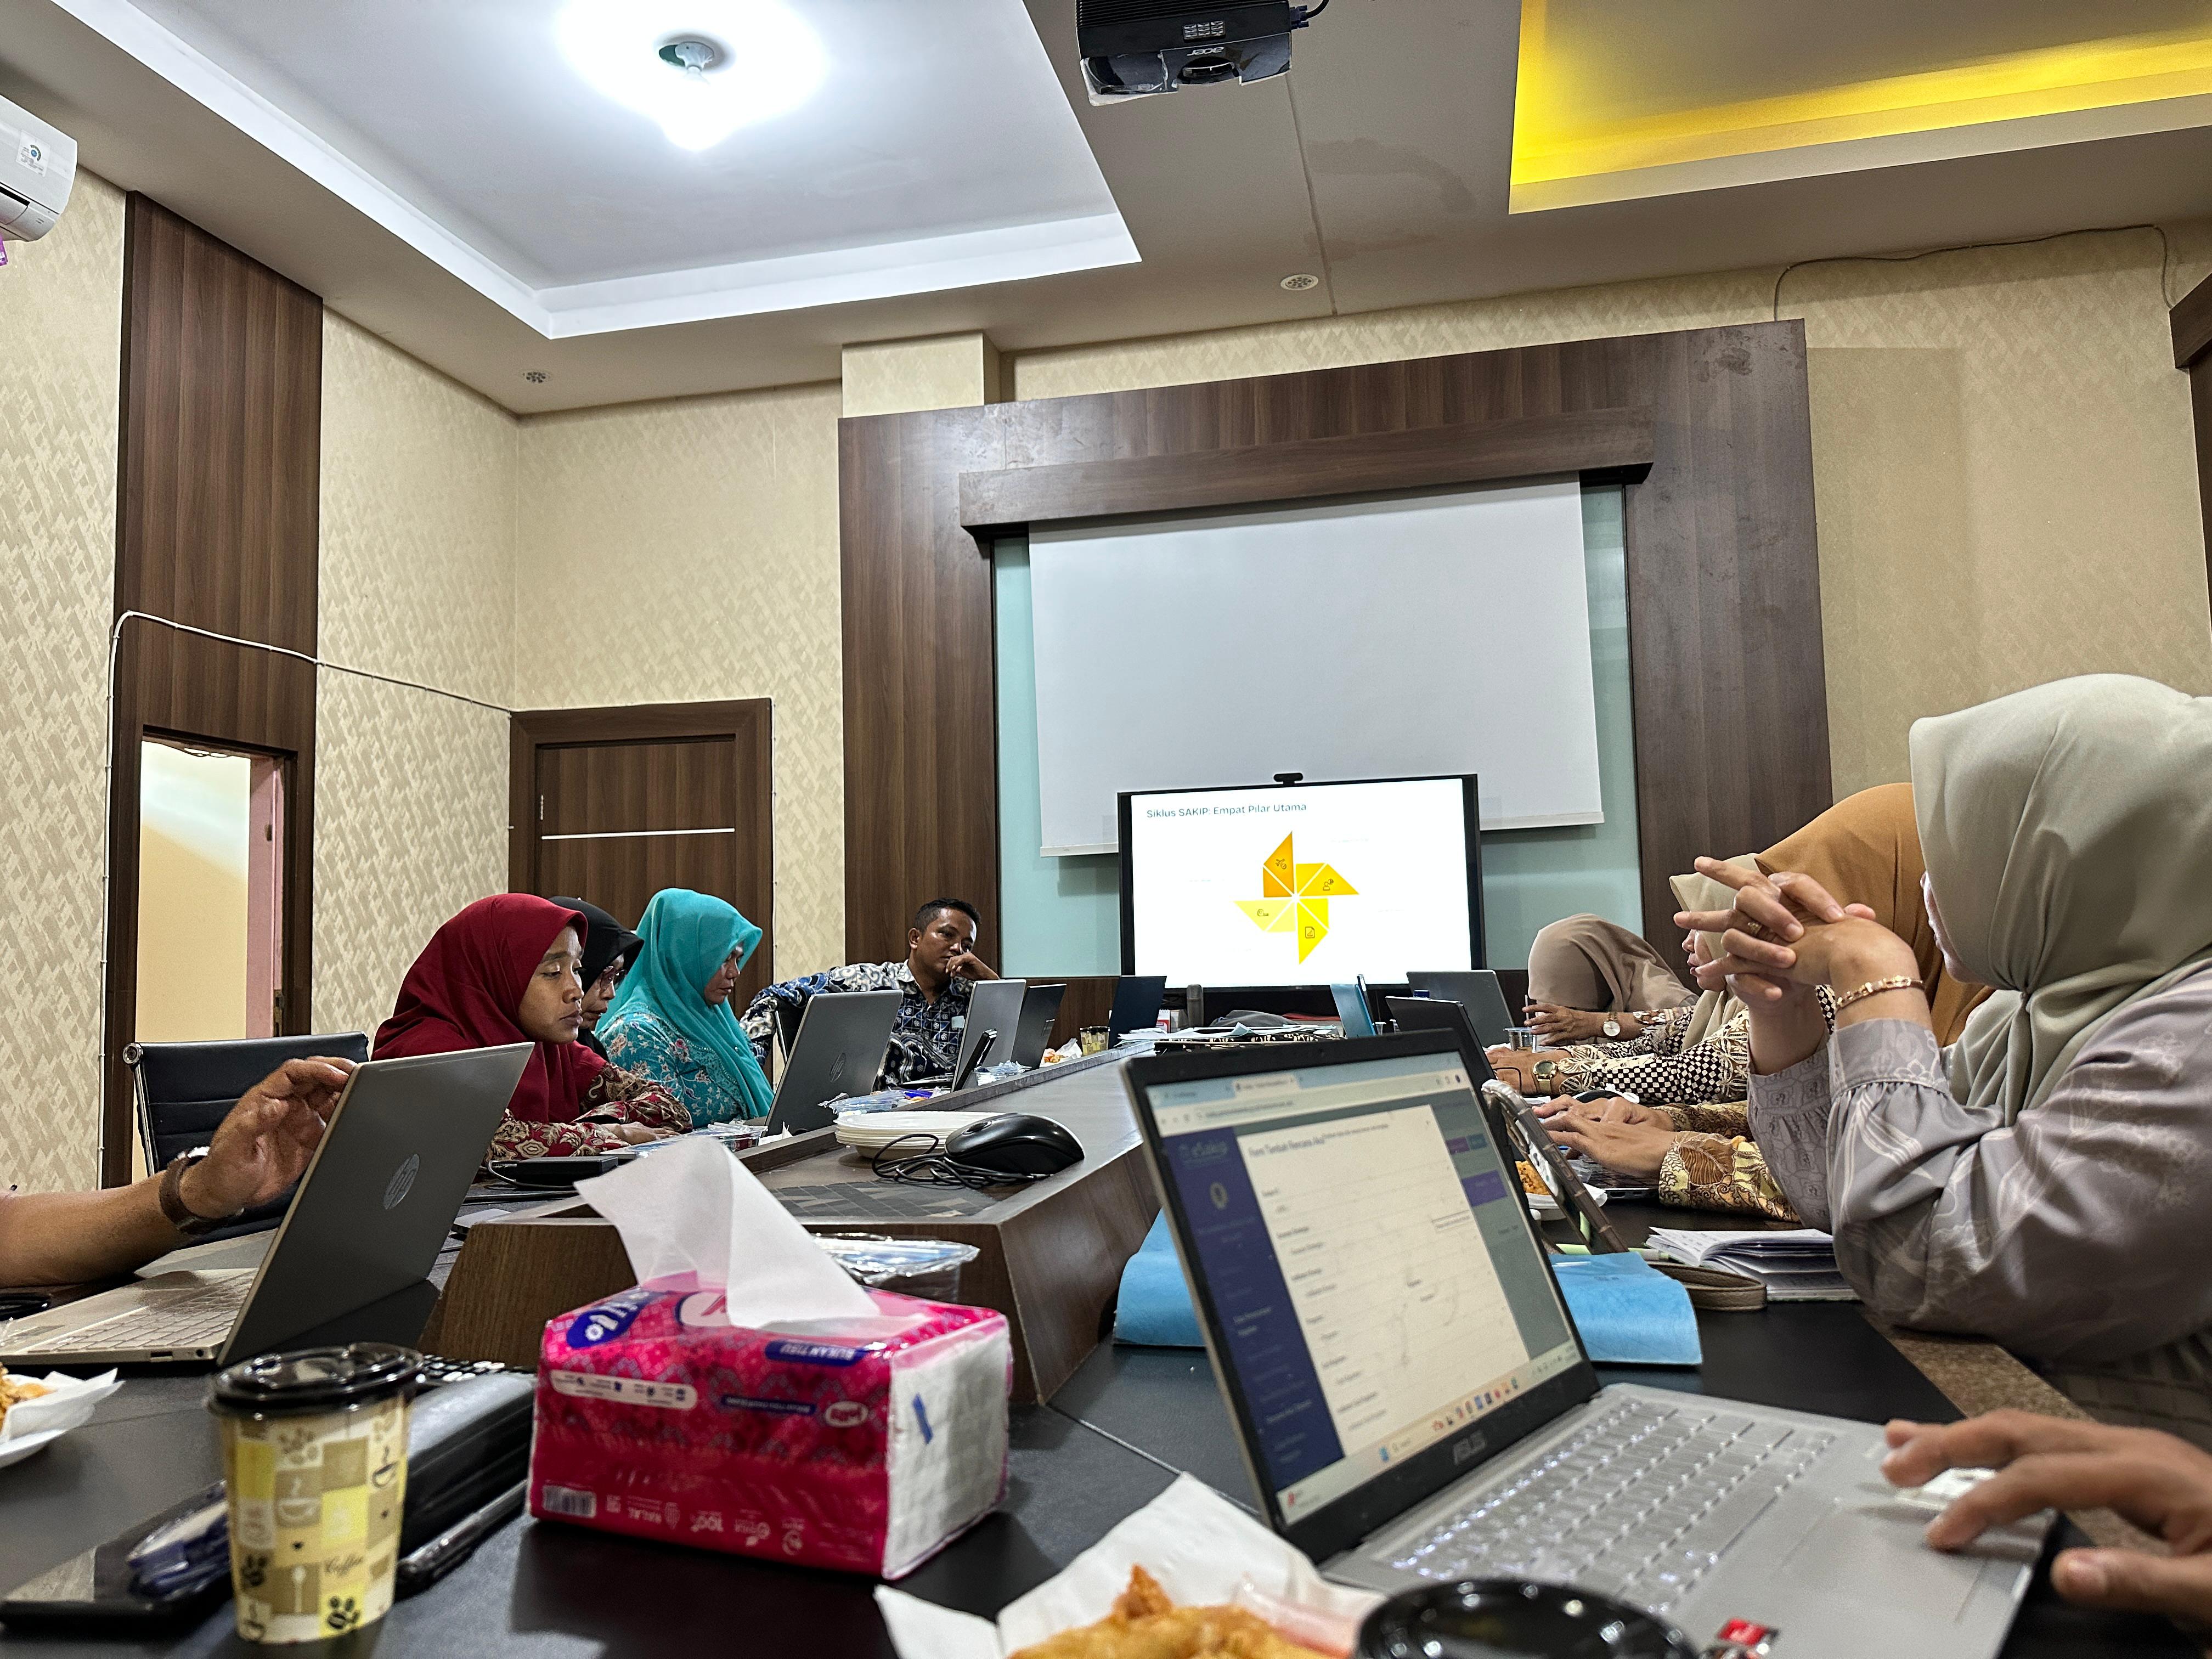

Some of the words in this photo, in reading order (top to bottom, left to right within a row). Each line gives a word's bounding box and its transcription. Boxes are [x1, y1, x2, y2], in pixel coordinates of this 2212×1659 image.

[1187, 47, 1224, 57] acer
[1147, 809, 1176, 818] Siklus
[1178, 808, 1211, 816] SAKIP:
[1214, 806, 1245, 816] Empat
[1248, 804, 1270, 812] Pilar
[1273, 804, 1306, 812] Utama
